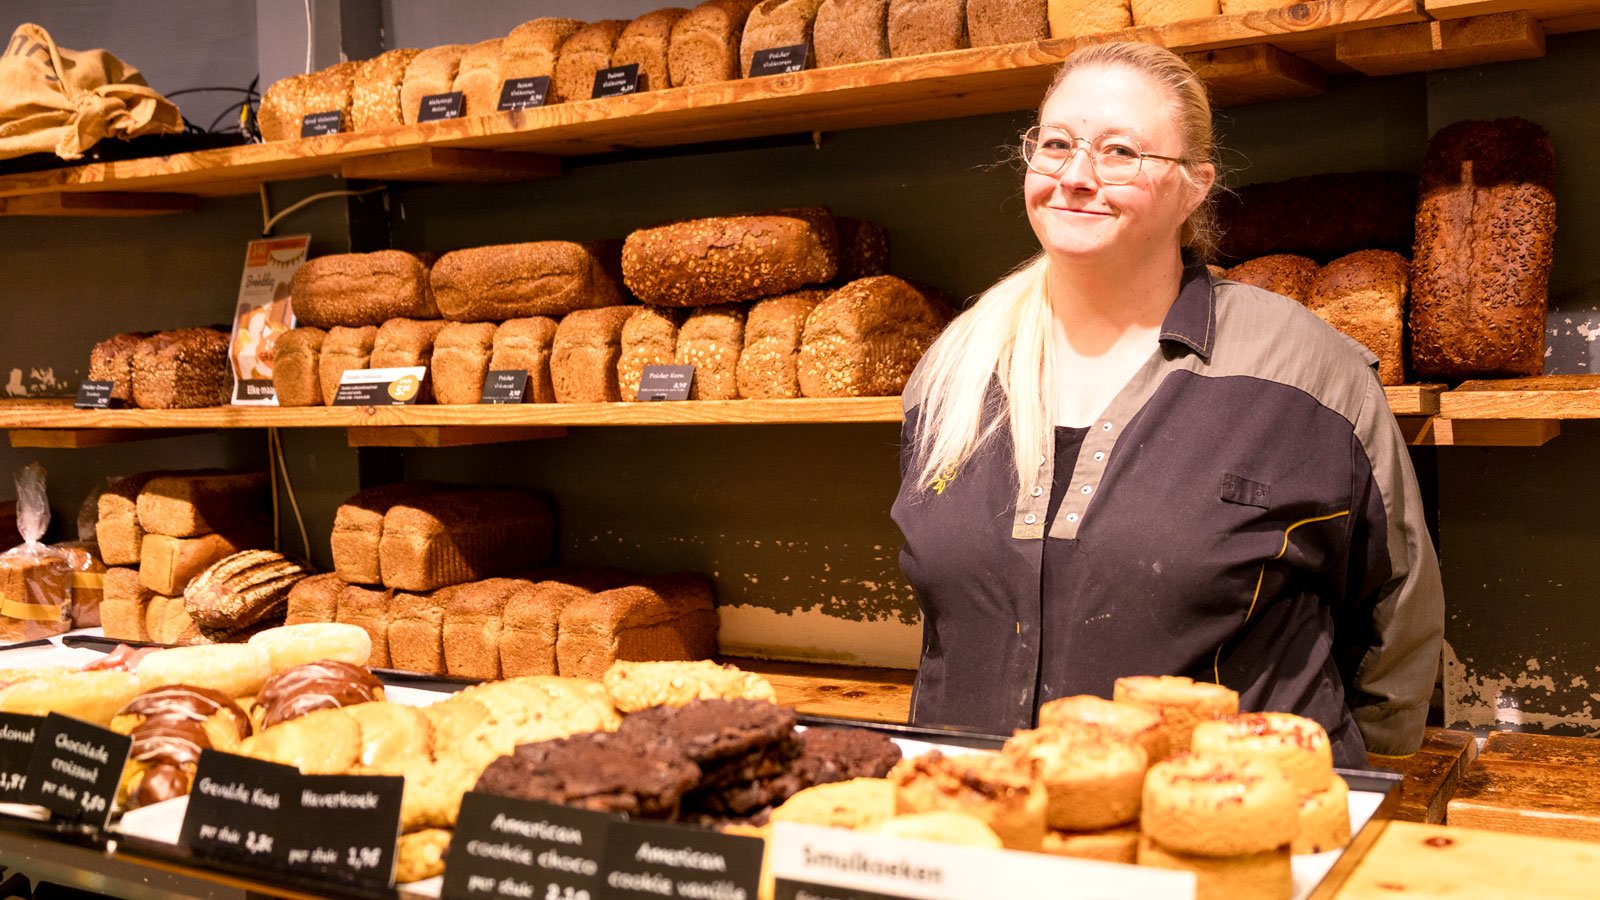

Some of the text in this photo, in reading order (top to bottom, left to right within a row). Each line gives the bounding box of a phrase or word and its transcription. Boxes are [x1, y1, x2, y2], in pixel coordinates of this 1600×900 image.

[246, 384, 261, 396] Elke
[54, 732, 109, 765] Chocolade
[51, 757, 99, 784] croissant
[199, 777, 250, 804] Gevulde
[300, 789, 380, 810] Haverkoek
[199, 824, 218, 840] per
[490, 812, 583, 846] American
[288, 849, 310, 865] per
[310, 847, 339, 864] stuk
[466, 839, 598, 876] cookie choco
[635, 841, 727, 873] American
[467, 874, 496, 893] per
[497, 876, 535, 898] stuk
[607, 870, 747, 900] cookie vanilla
